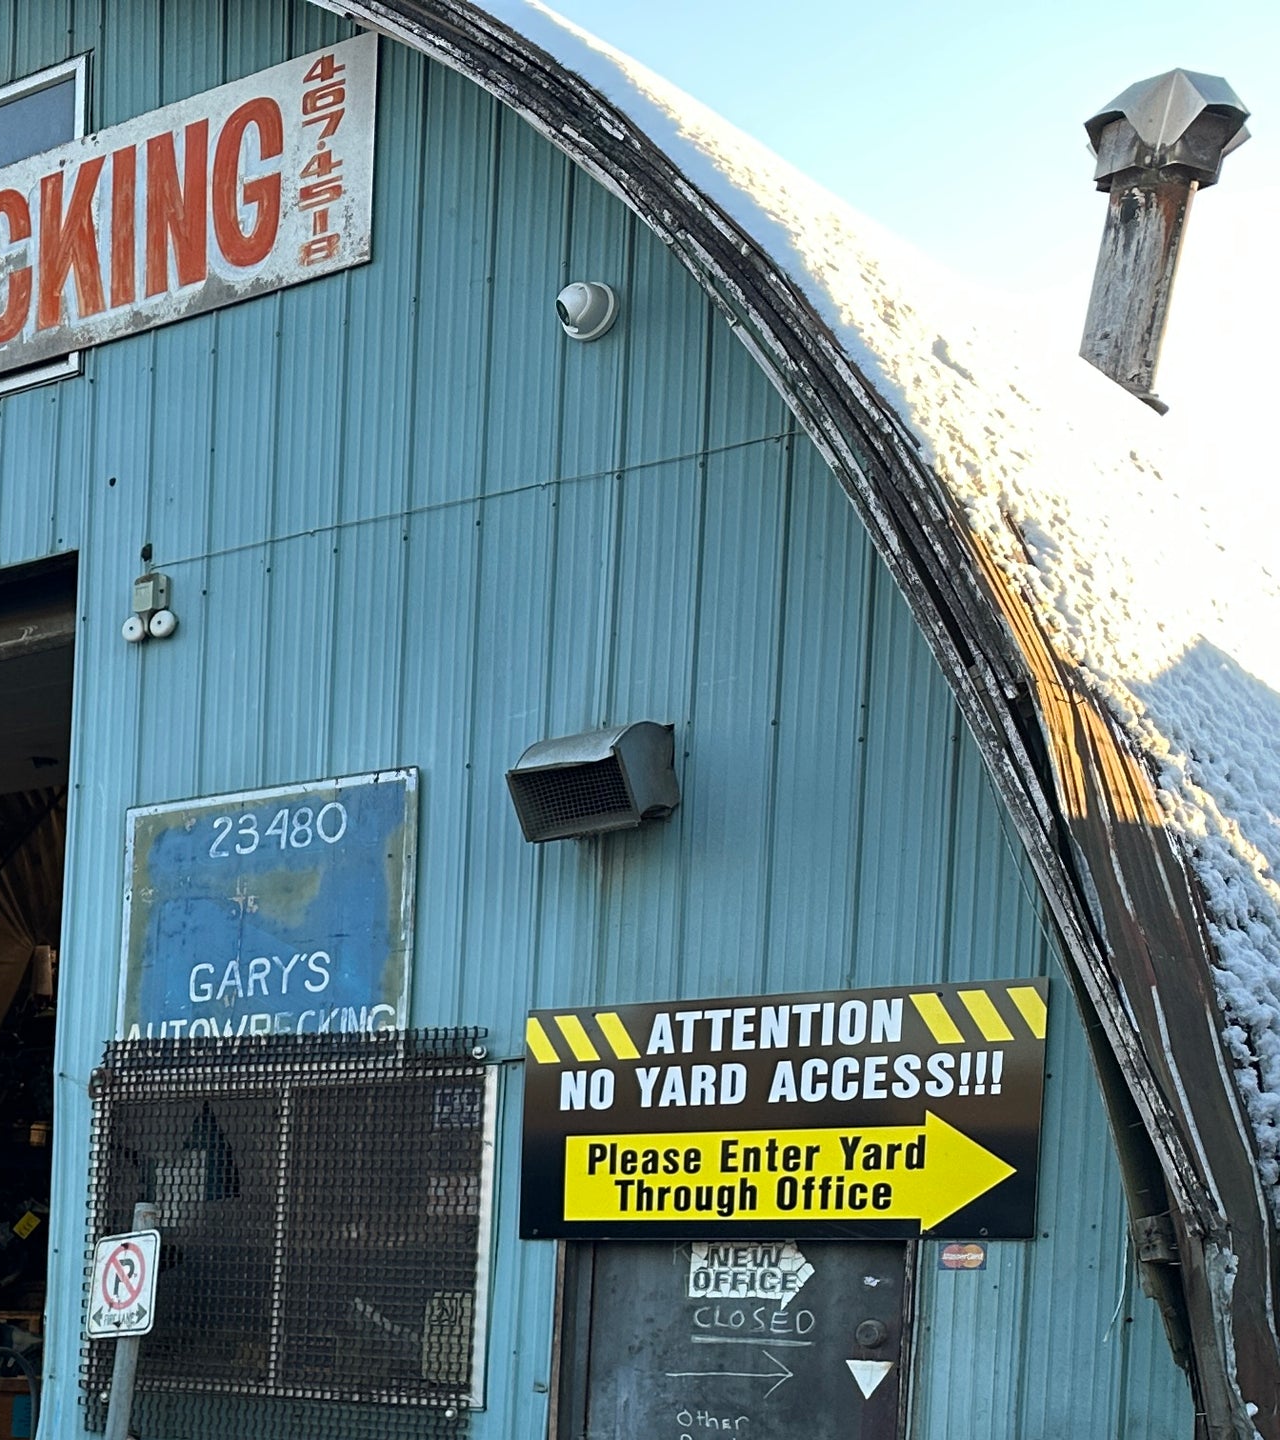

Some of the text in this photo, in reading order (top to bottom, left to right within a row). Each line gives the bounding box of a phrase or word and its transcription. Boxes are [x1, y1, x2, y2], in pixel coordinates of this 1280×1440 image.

[208, 802, 348, 859] 23480
[188, 950, 331, 1003] GARY'S
[646, 997, 904, 1056] ATTENTION
[559, 1049, 1004, 1112] NO YARD ACCESS!!!
[588, 1133, 927, 1176] Please Enter Yard
[614, 1175, 893, 1218] Through Office
[708, 1246, 783, 1269] NEW
[692, 1268, 799, 1293] OFFICE
[693, 1306, 816, 1335] CLOSED
[676, 1409, 750, 1430] Other
